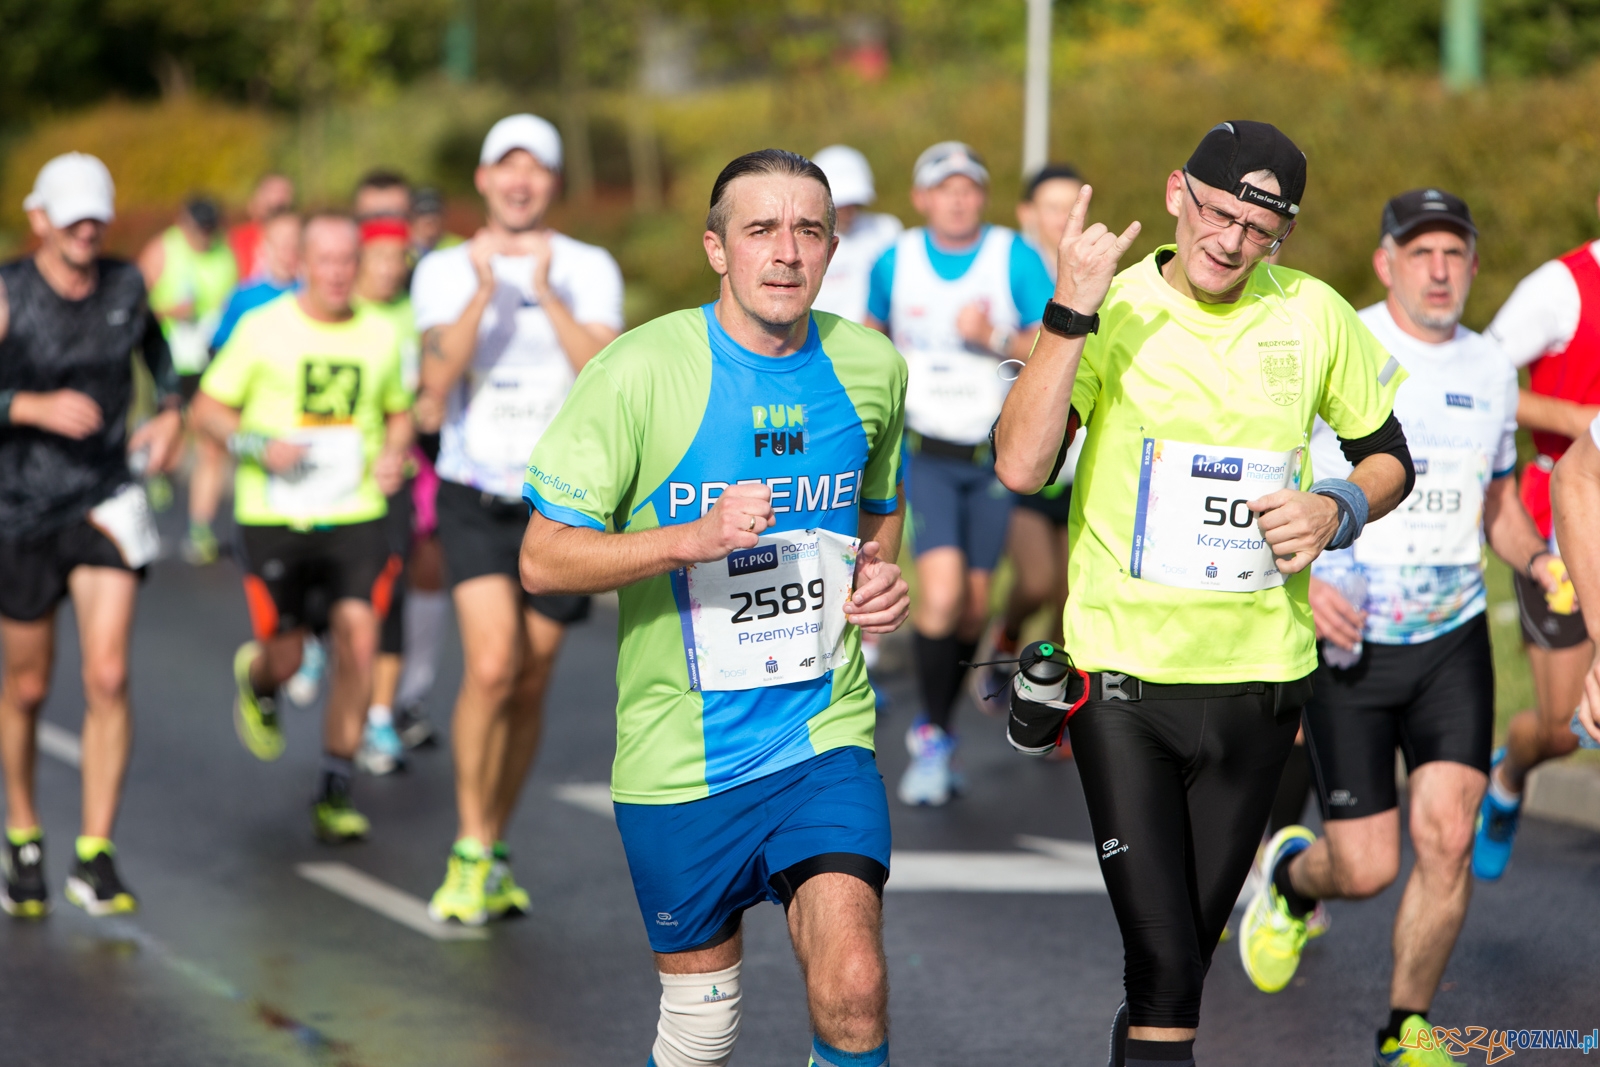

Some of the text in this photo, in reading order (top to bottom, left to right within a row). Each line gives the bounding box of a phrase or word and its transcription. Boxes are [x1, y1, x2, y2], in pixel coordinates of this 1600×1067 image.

[1249, 190, 1287, 209] Kalenji
[751, 403, 803, 429] RUN
[754, 431, 804, 457] FUN
[1393, 489, 1462, 514] 283
[1197, 533, 1267, 550] Krzysztof
[730, 577, 825, 624] 2589
